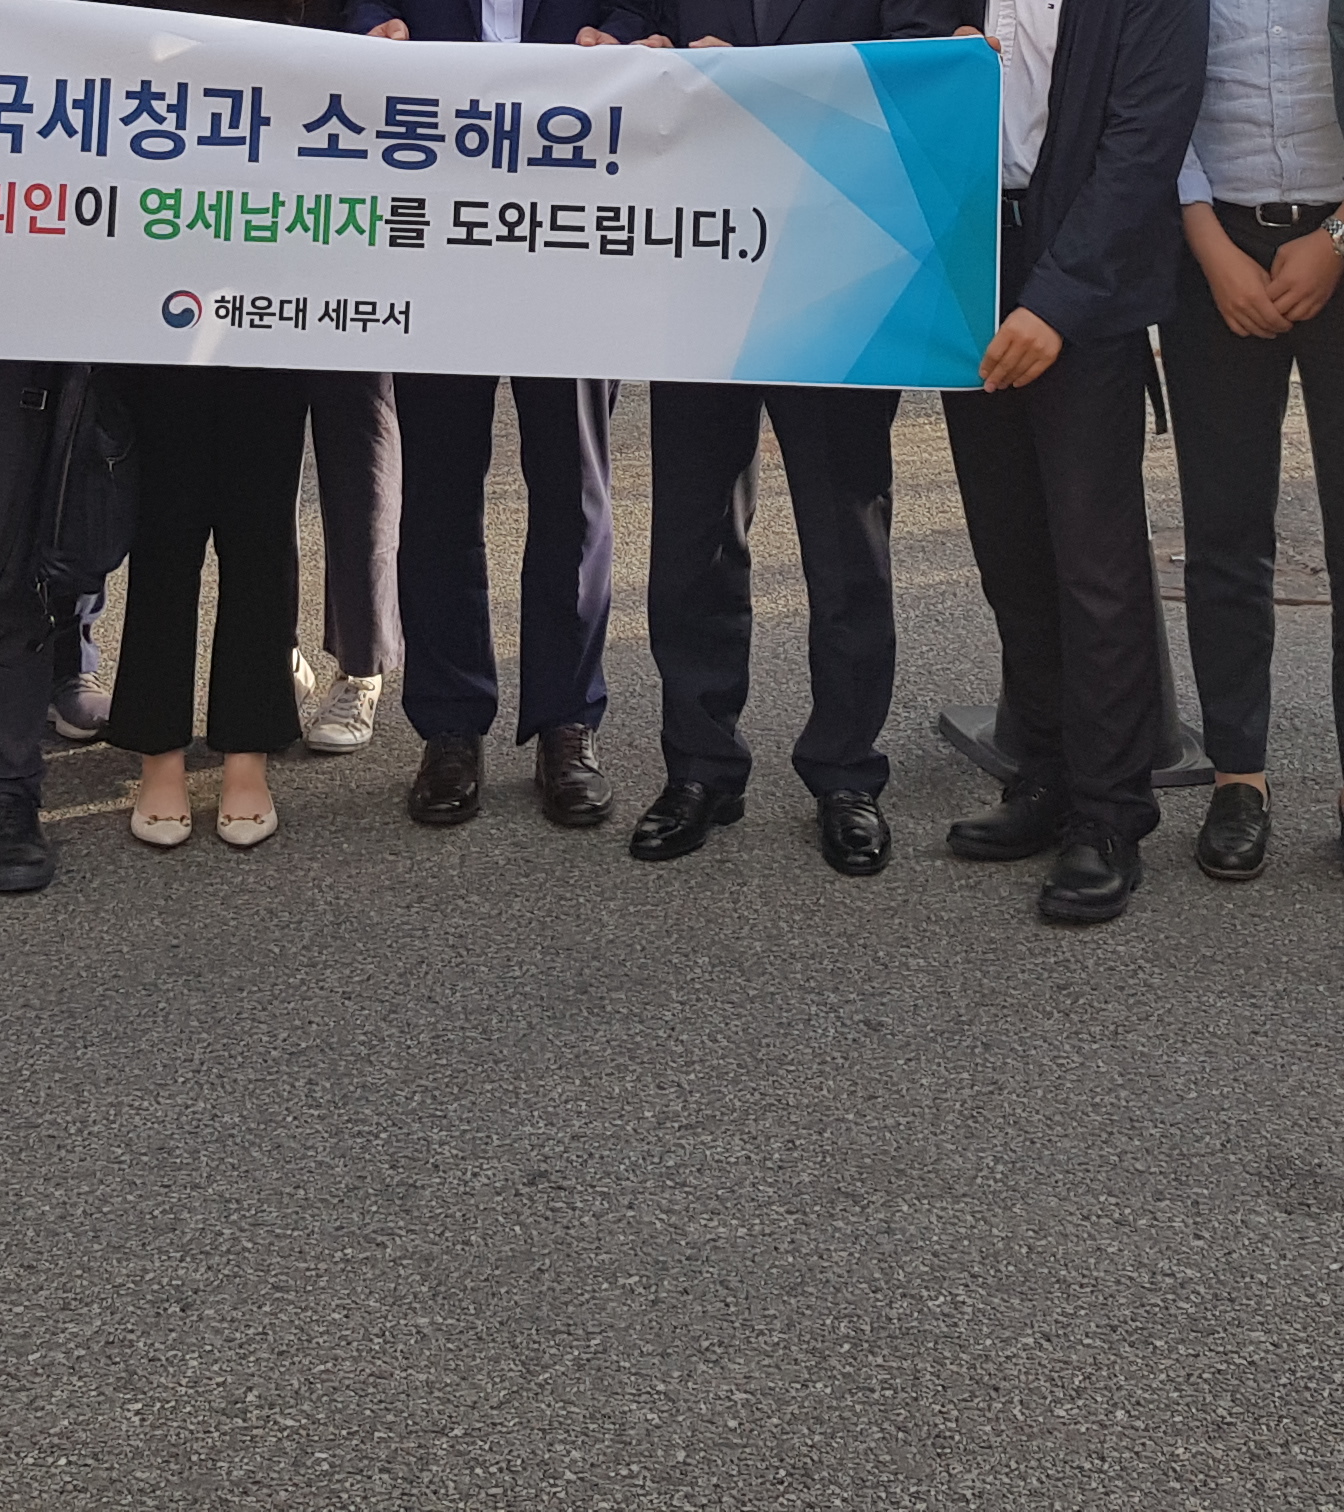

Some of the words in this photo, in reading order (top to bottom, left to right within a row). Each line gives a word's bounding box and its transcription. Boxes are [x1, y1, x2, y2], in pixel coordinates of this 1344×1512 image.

[297, 93, 622, 175] 소통해요!
[139, 187, 431, 249] 영세납세자를
[445, 198, 768, 264] 도와드립니다.)
[213, 294, 308, 331] 해운대
[317, 298, 412, 335] 세무서
